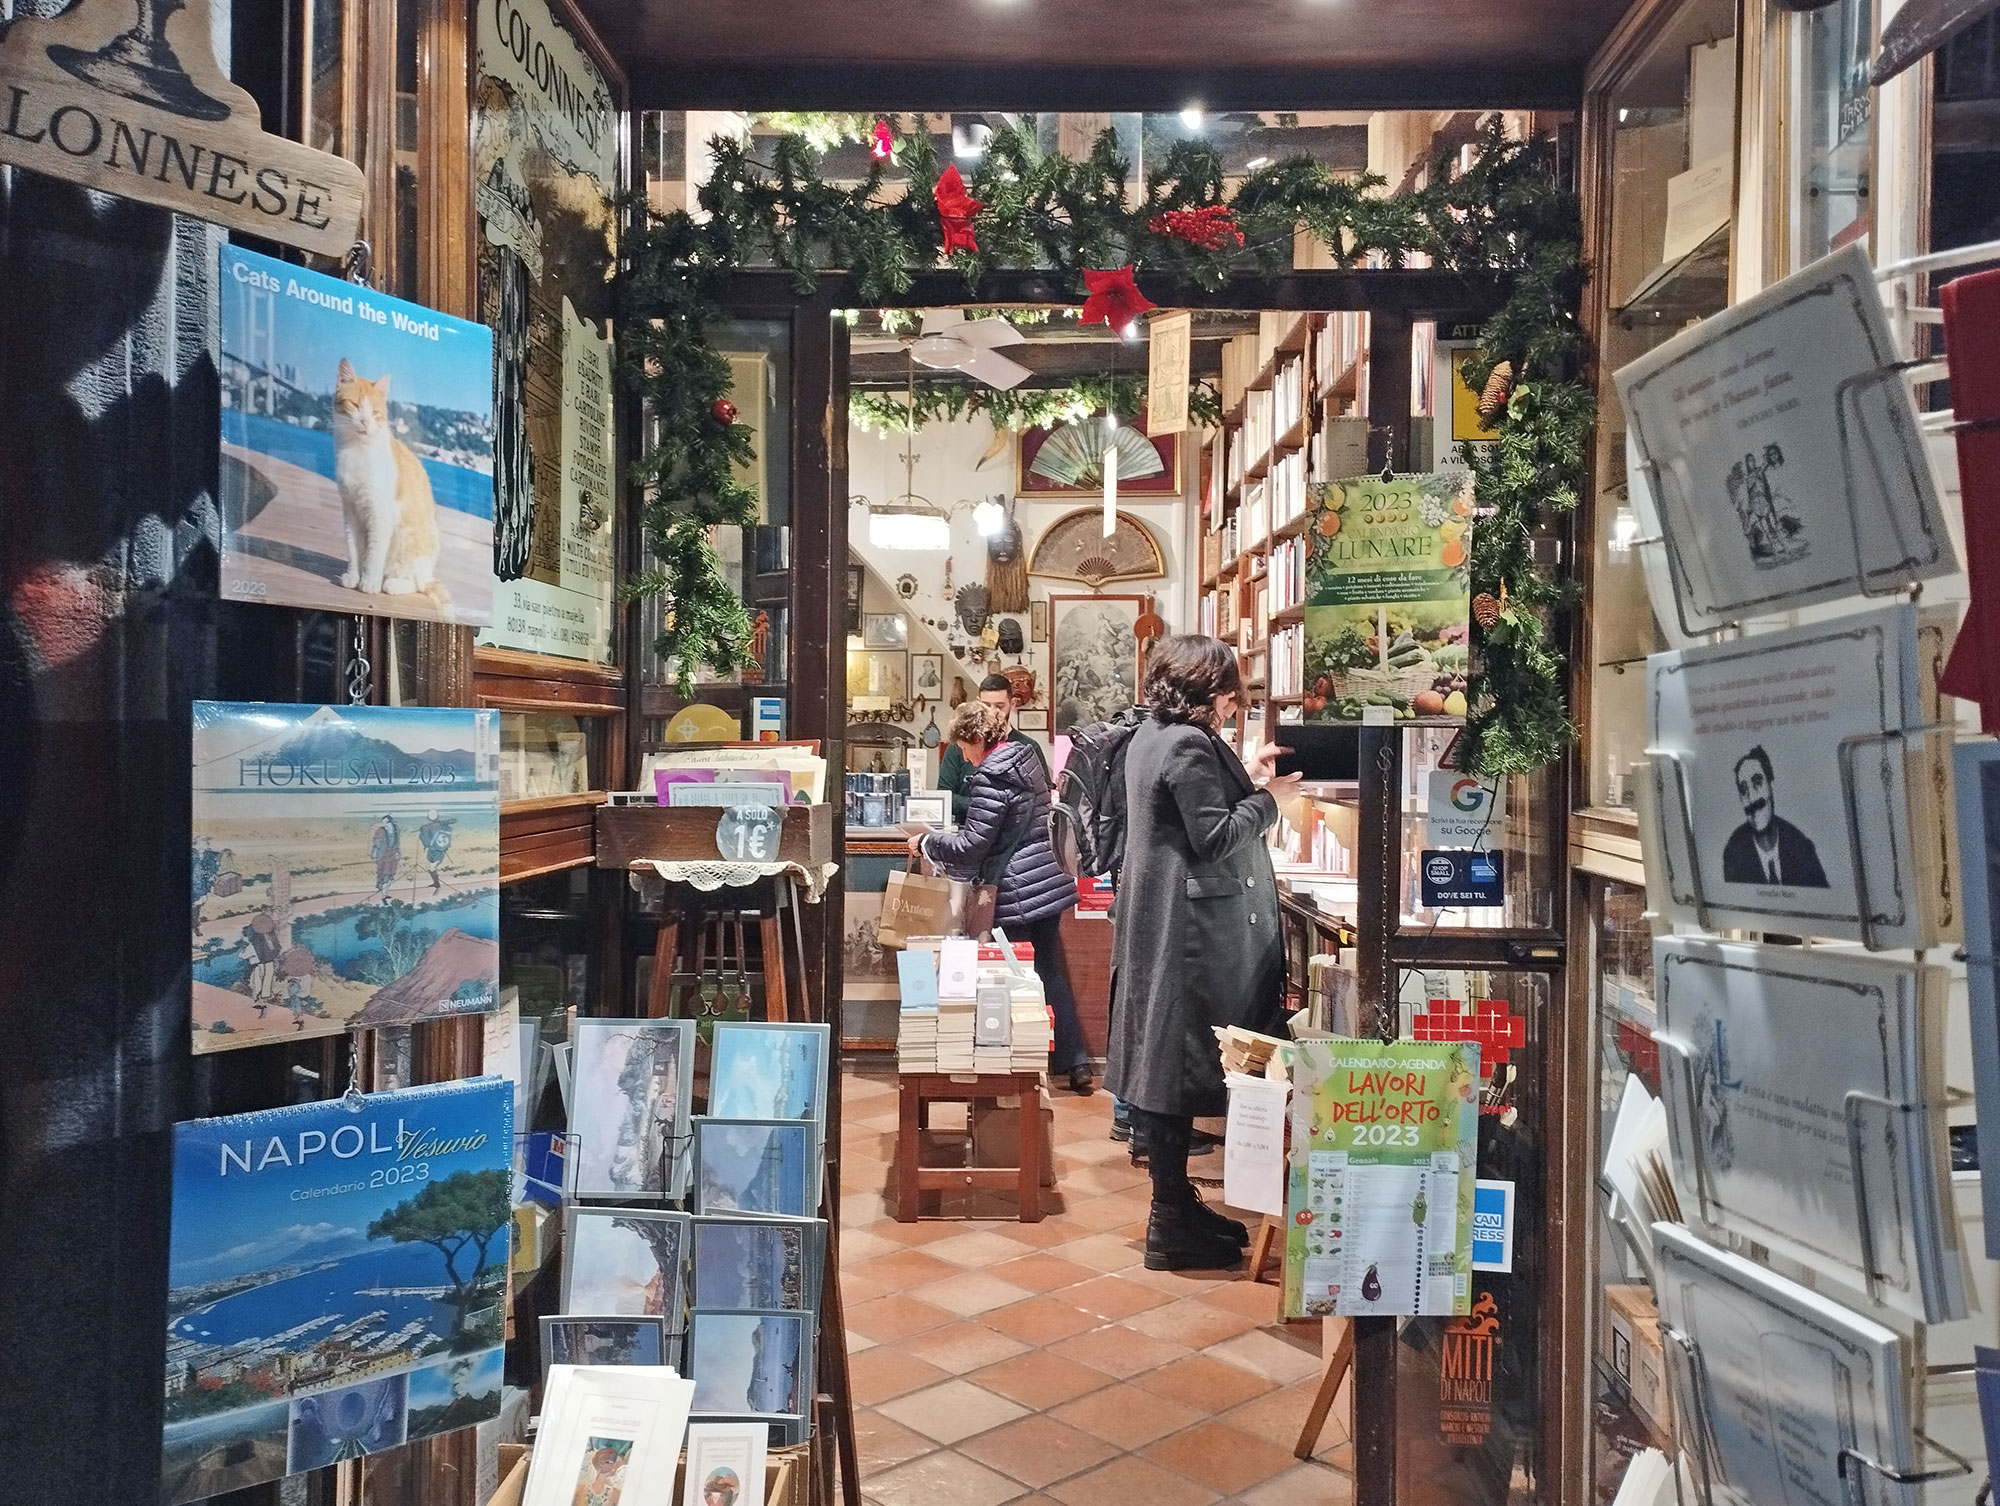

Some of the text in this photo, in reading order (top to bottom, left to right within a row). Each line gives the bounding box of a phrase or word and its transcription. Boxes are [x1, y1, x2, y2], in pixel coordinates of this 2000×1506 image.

[495, 0, 602, 160] COLONNESE
[2, 86, 332, 232] LONNESE
[232, 261, 440, 342] Cats Around the World
[1451, 445, 1478, 453] ARA
[1360, 491, 1413, 512] 2023
[1348, 524, 1420, 539] CALENDARIO
[1338, 535, 1432, 560] LUNARE
[232, 579, 269, 597] 2023
[1347, 576, 1356, 584] 12
[1357, 576, 1373, 584] mesi
[1374, 574, 1382, 583] di
[1398, 573, 1407, 582] da
[1408, 572, 1423, 582] fare
[237, 757, 457, 787] HOKUSAI 2023
[736, 809, 768, 821] A SOLO
[1441, 827, 1453, 835] su
[449, 994, 493, 1010] NEUMANN
[1348, 1071, 1425, 1097] LAVORI
[1333, 1098, 1440, 1125] DELL'ORTO
[220, 1117, 489, 1177] NAPOLI Vesuvio
[1352, 1124, 1420, 1147] 2023
[1349, 1156, 1379, 1165] Gennaio
[289, 1161, 430, 1202] Calendario 2023
[1440, 1333, 1493, 1381] MITI
[1454, 1379, 1492, 1403] NAPOLI
